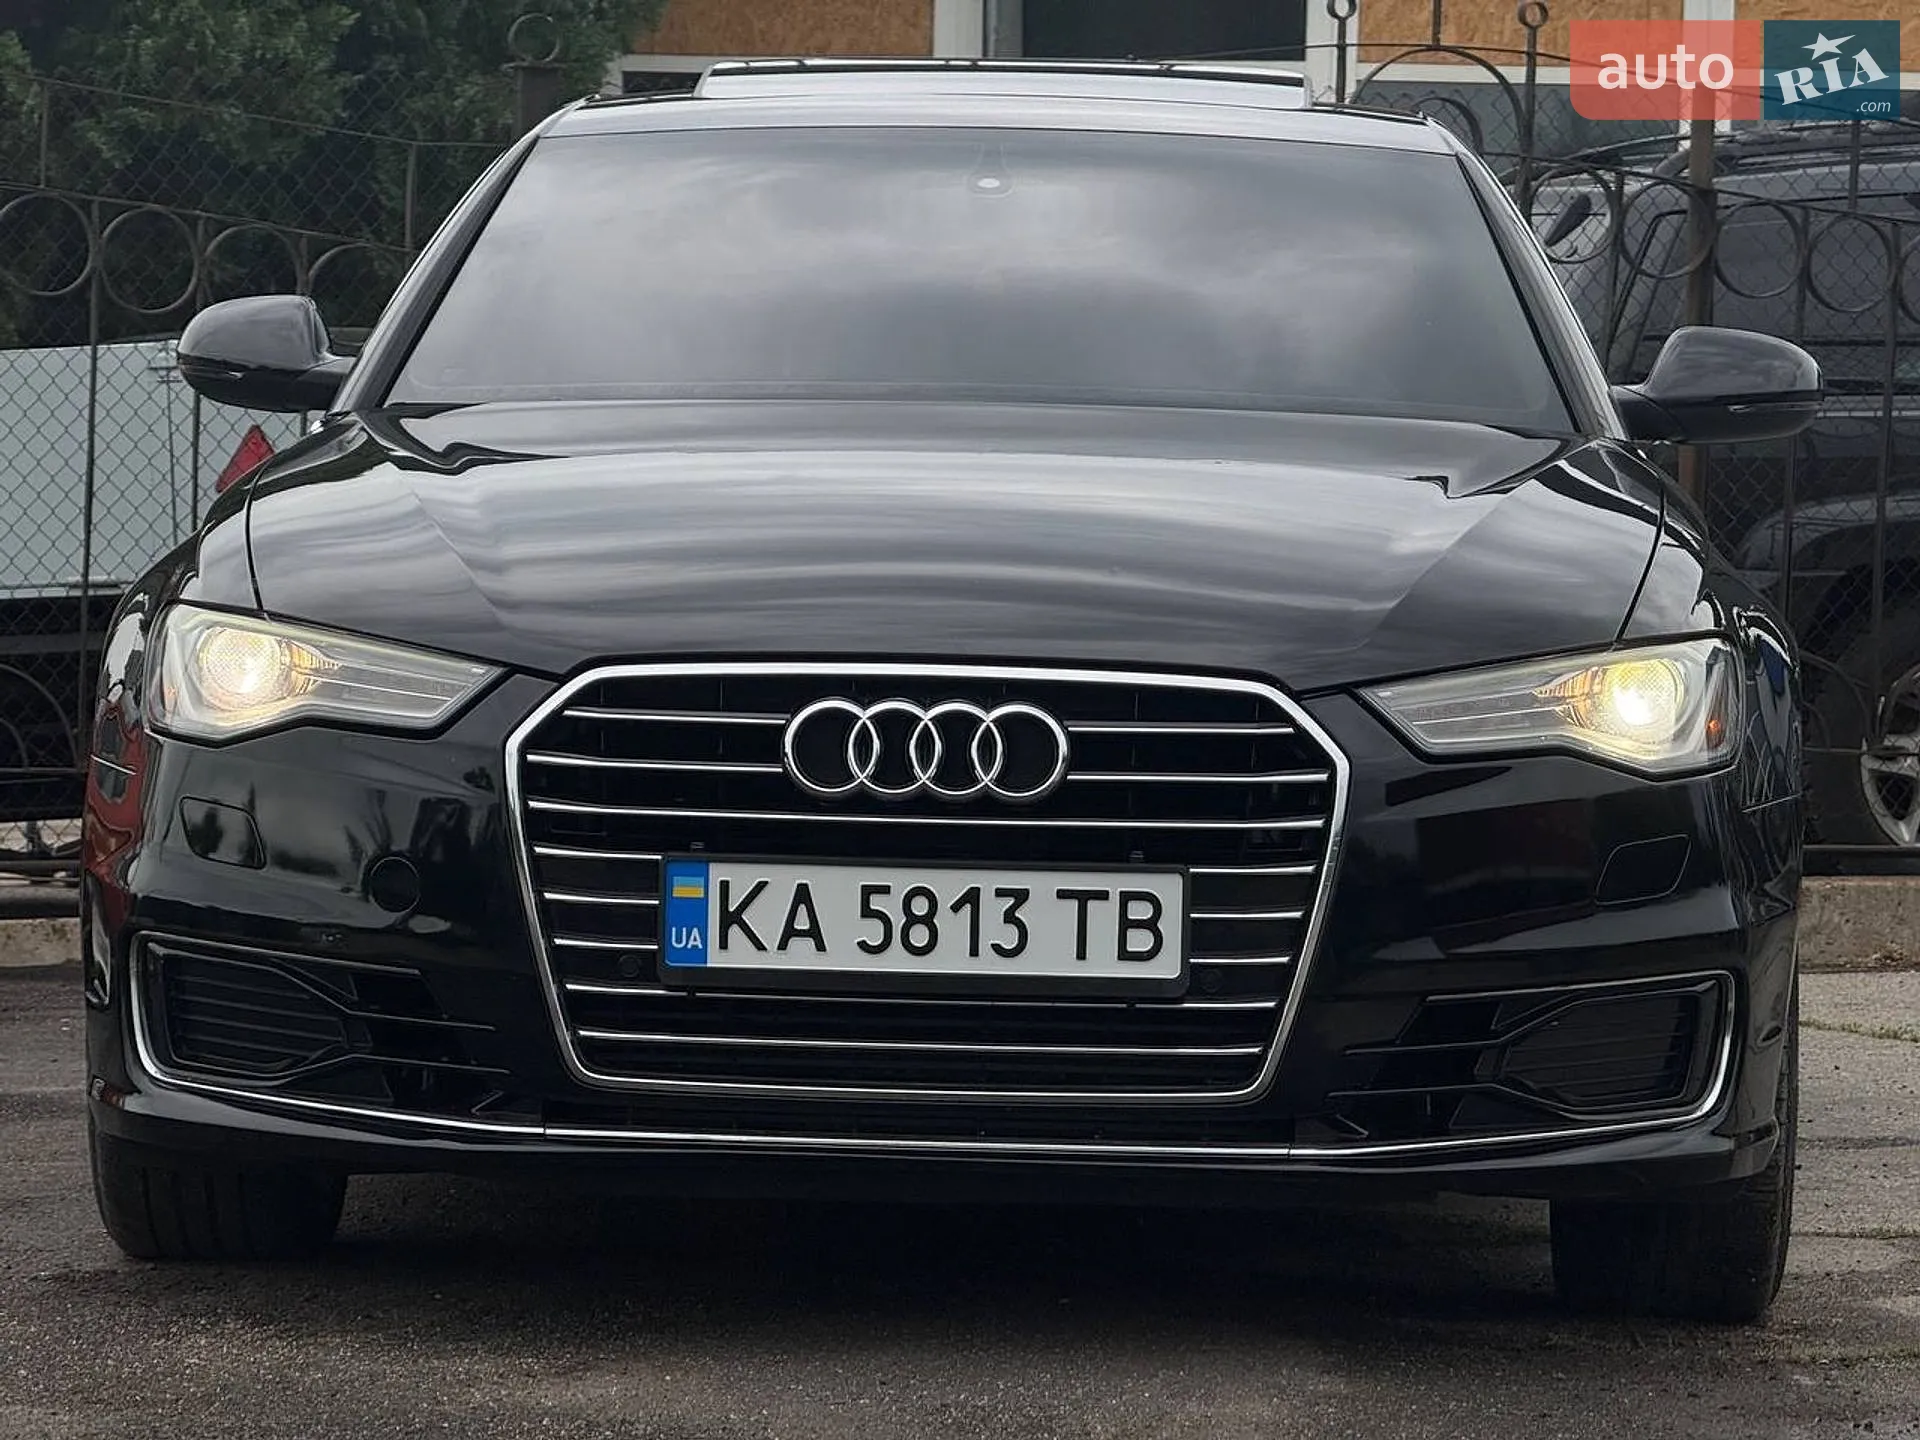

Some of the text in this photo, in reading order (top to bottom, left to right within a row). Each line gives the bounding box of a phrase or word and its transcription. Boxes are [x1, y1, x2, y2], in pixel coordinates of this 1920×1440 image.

[671, 927, 702, 949] UA
[718, 880, 1164, 961] KA 5813 TB
